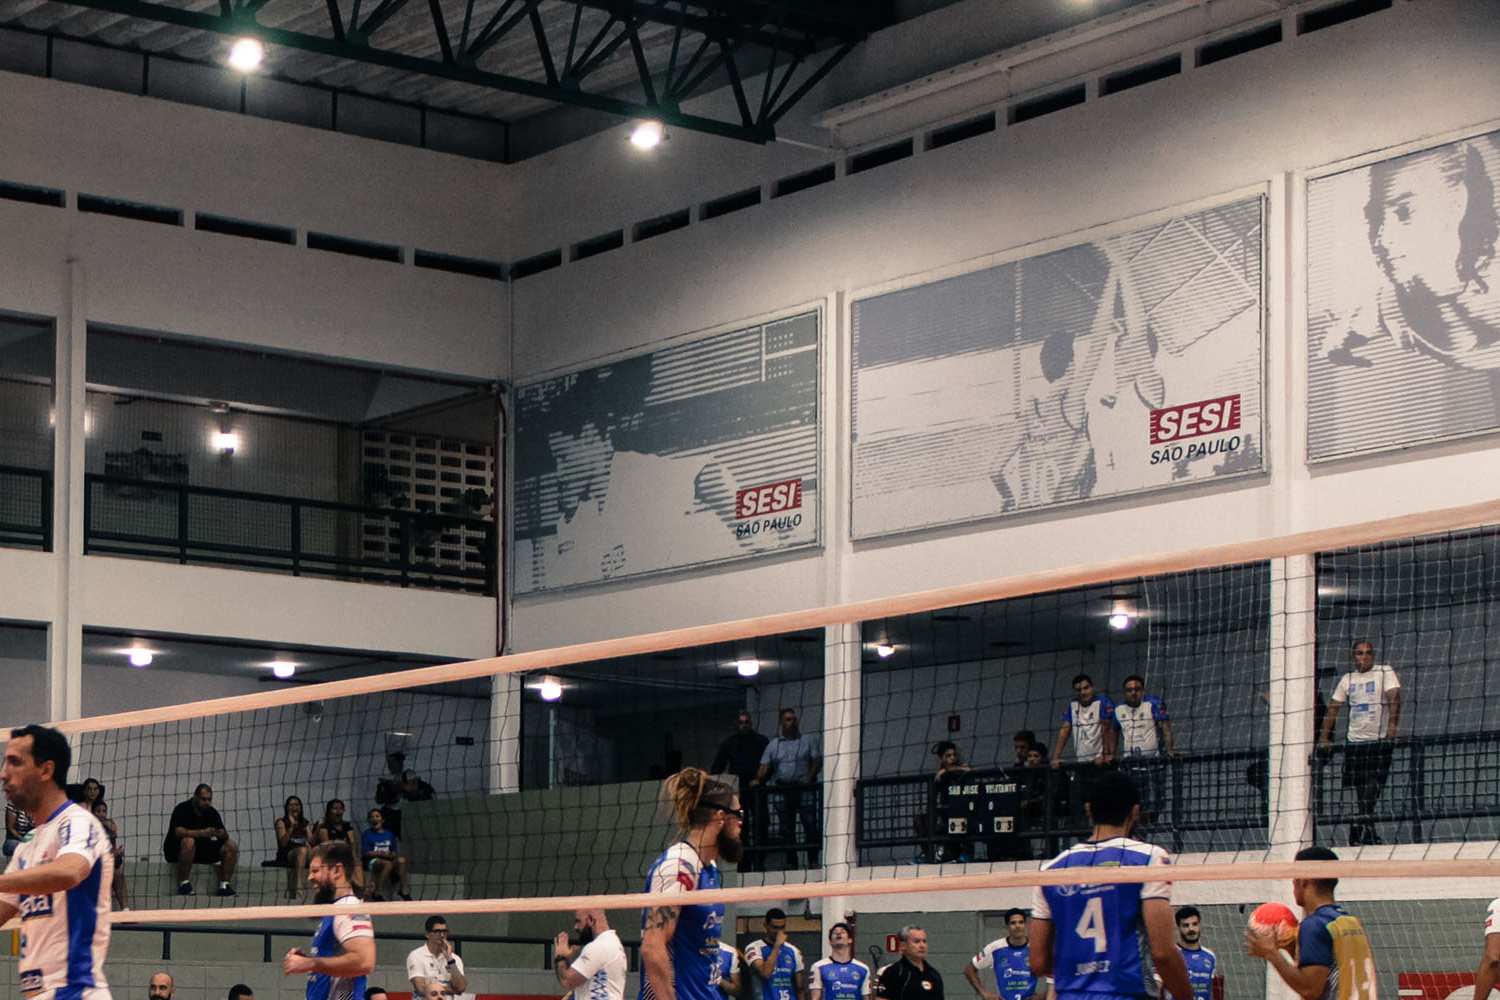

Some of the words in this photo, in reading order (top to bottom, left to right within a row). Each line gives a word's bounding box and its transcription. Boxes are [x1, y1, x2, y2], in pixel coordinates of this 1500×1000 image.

[1157, 399, 1233, 440] SESI
[1150, 444, 1183, 465] SÃO
[1187, 435, 1241, 459] PAULO
[741, 482, 797, 517] SESI
[736, 519, 760, 538] SÃO
[763, 513, 802, 532] PAULO
[985, 783, 1017, 794] VISITANTE
[1076, 896, 1107, 952] 4
